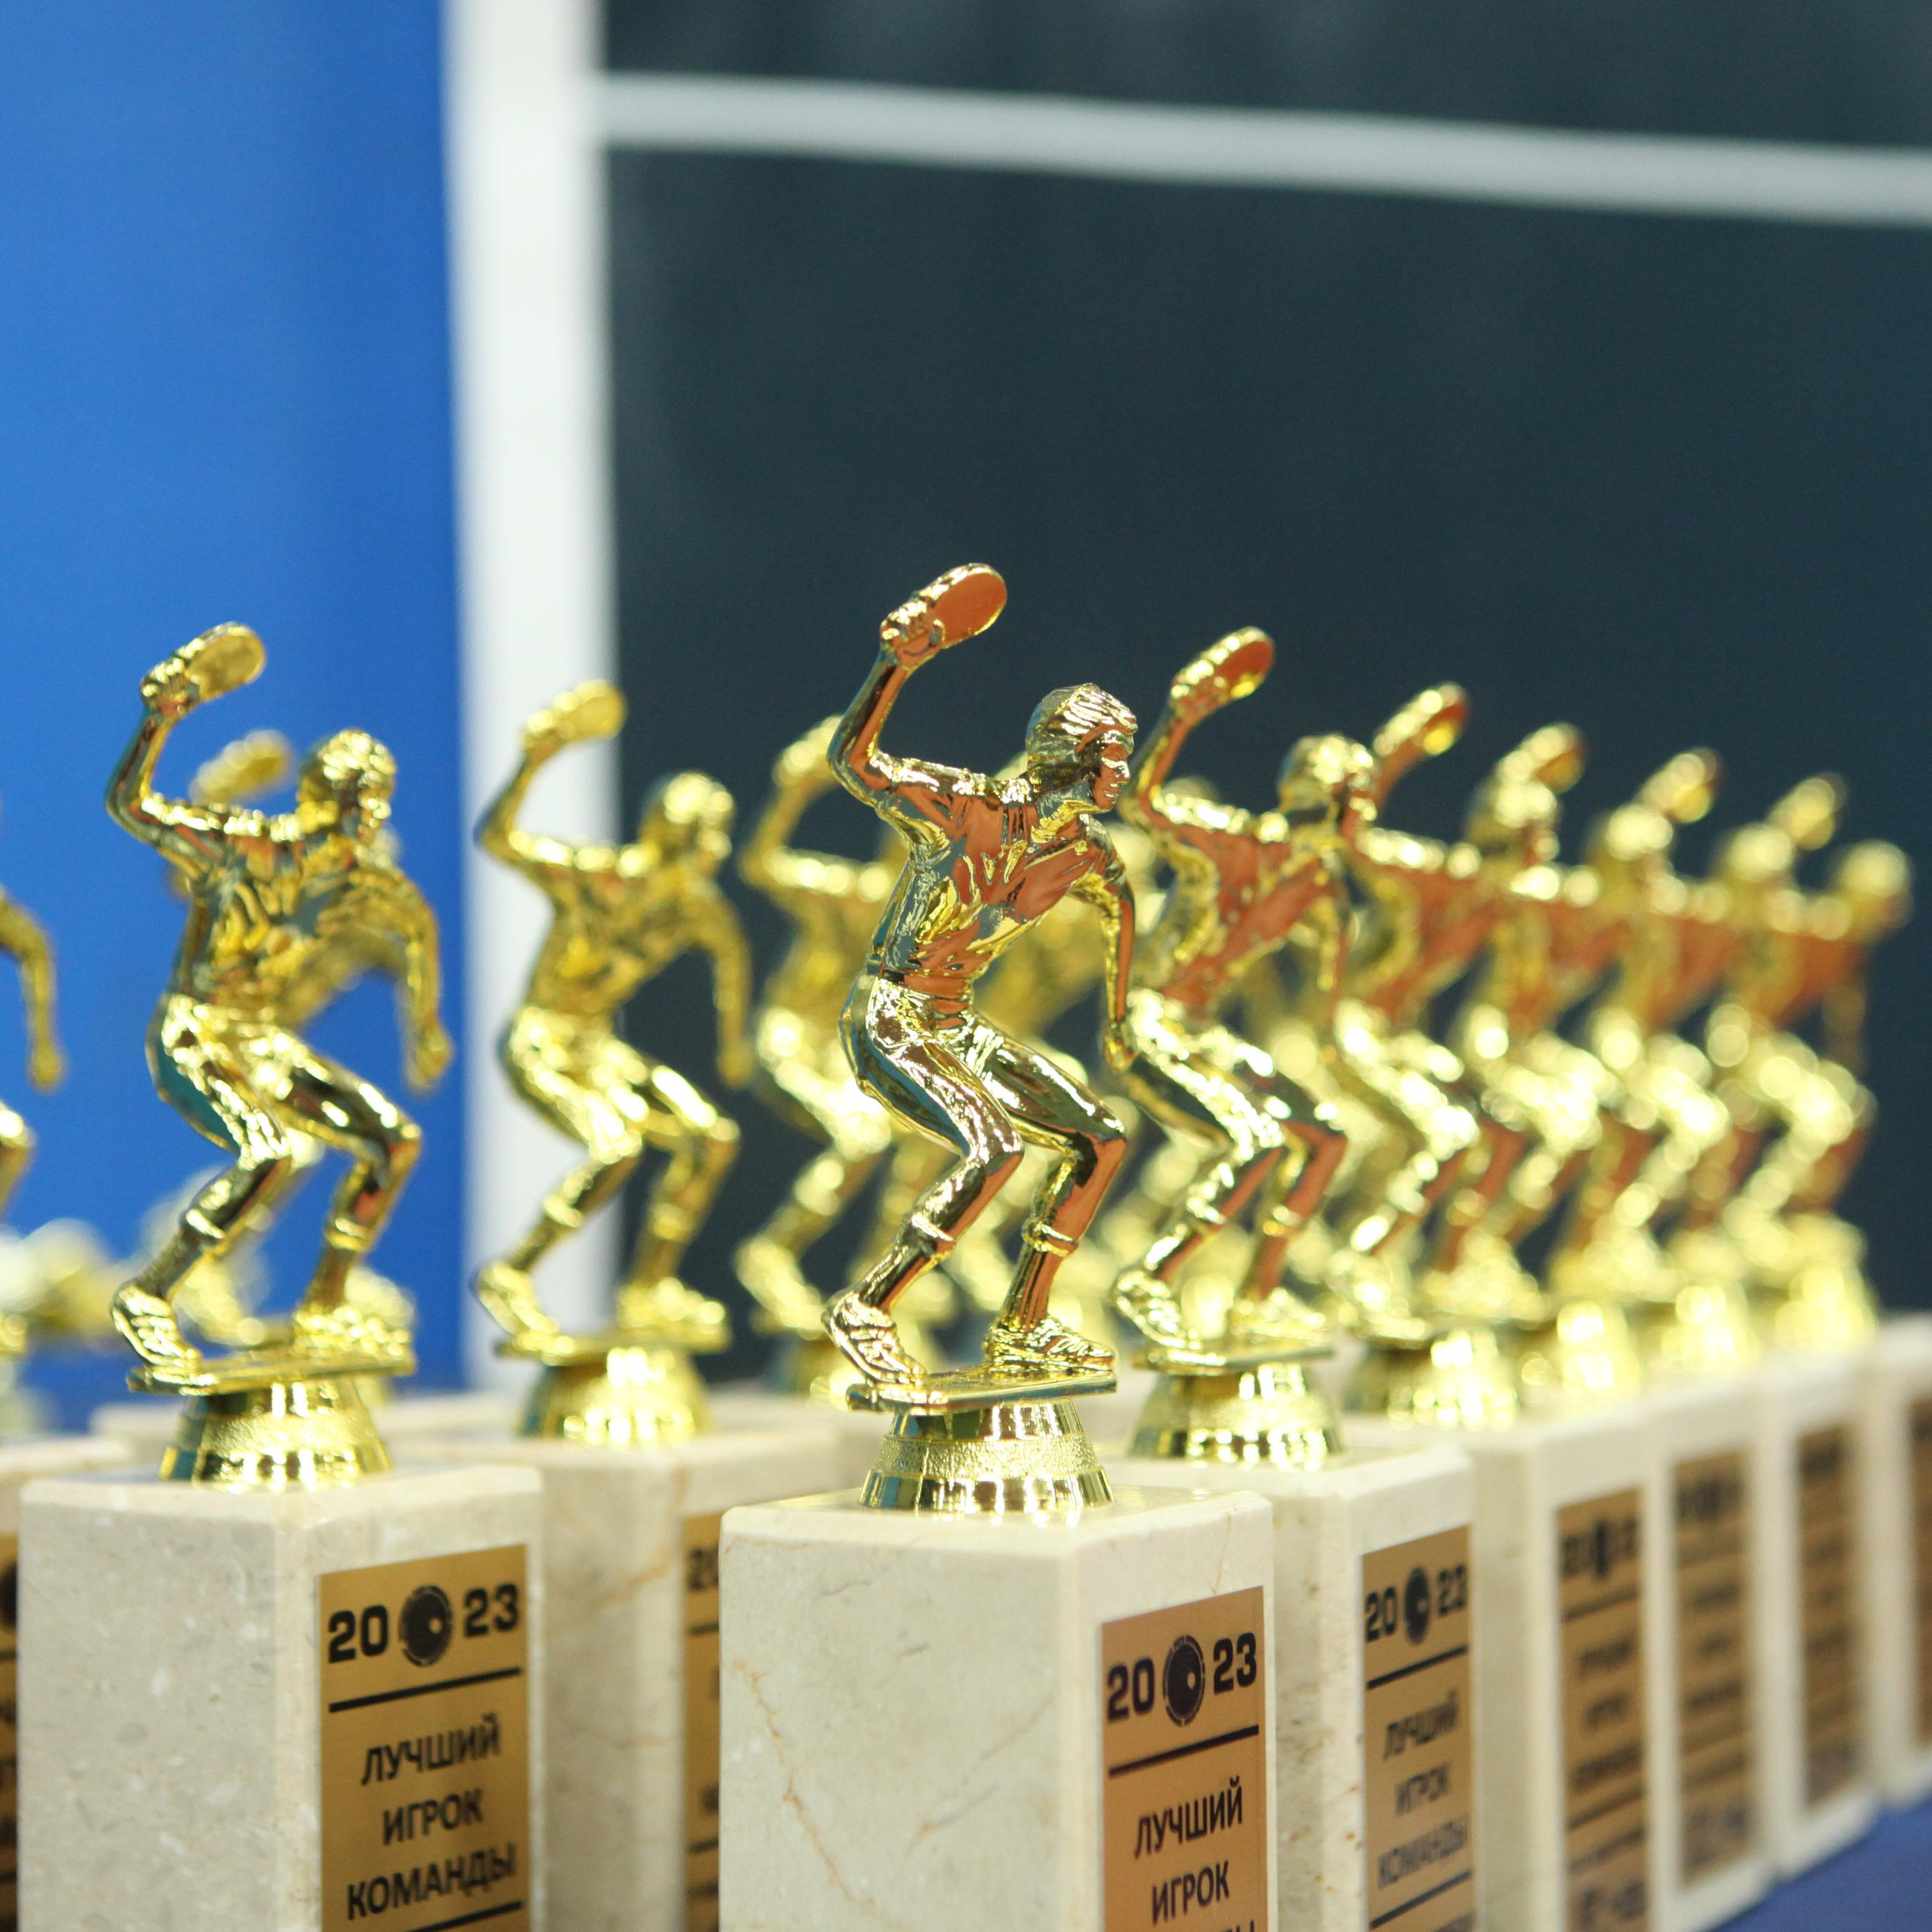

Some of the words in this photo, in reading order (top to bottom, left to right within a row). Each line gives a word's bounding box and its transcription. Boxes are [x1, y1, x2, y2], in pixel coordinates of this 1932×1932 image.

[328, 1604, 389, 1663] 20
[463, 1583, 520, 1638] 23
[1365, 1586, 1398, 1642] 20
[1437, 1564, 1466, 1618] 23
[1106, 1658, 1155, 1722] 20
[1213, 1632, 1257, 1695] 23
[361, 1712, 500, 1786] ЛУЧШИЙ
[383, 1786, 484, 1846] ИГРОК
[1134, 1775, 1243, 1860] ЛУЧШИЙ
[347, 1842, 516, 1921] КОМАНДЫ
[1151, 1860, 1230, 1925] ИГРОК
